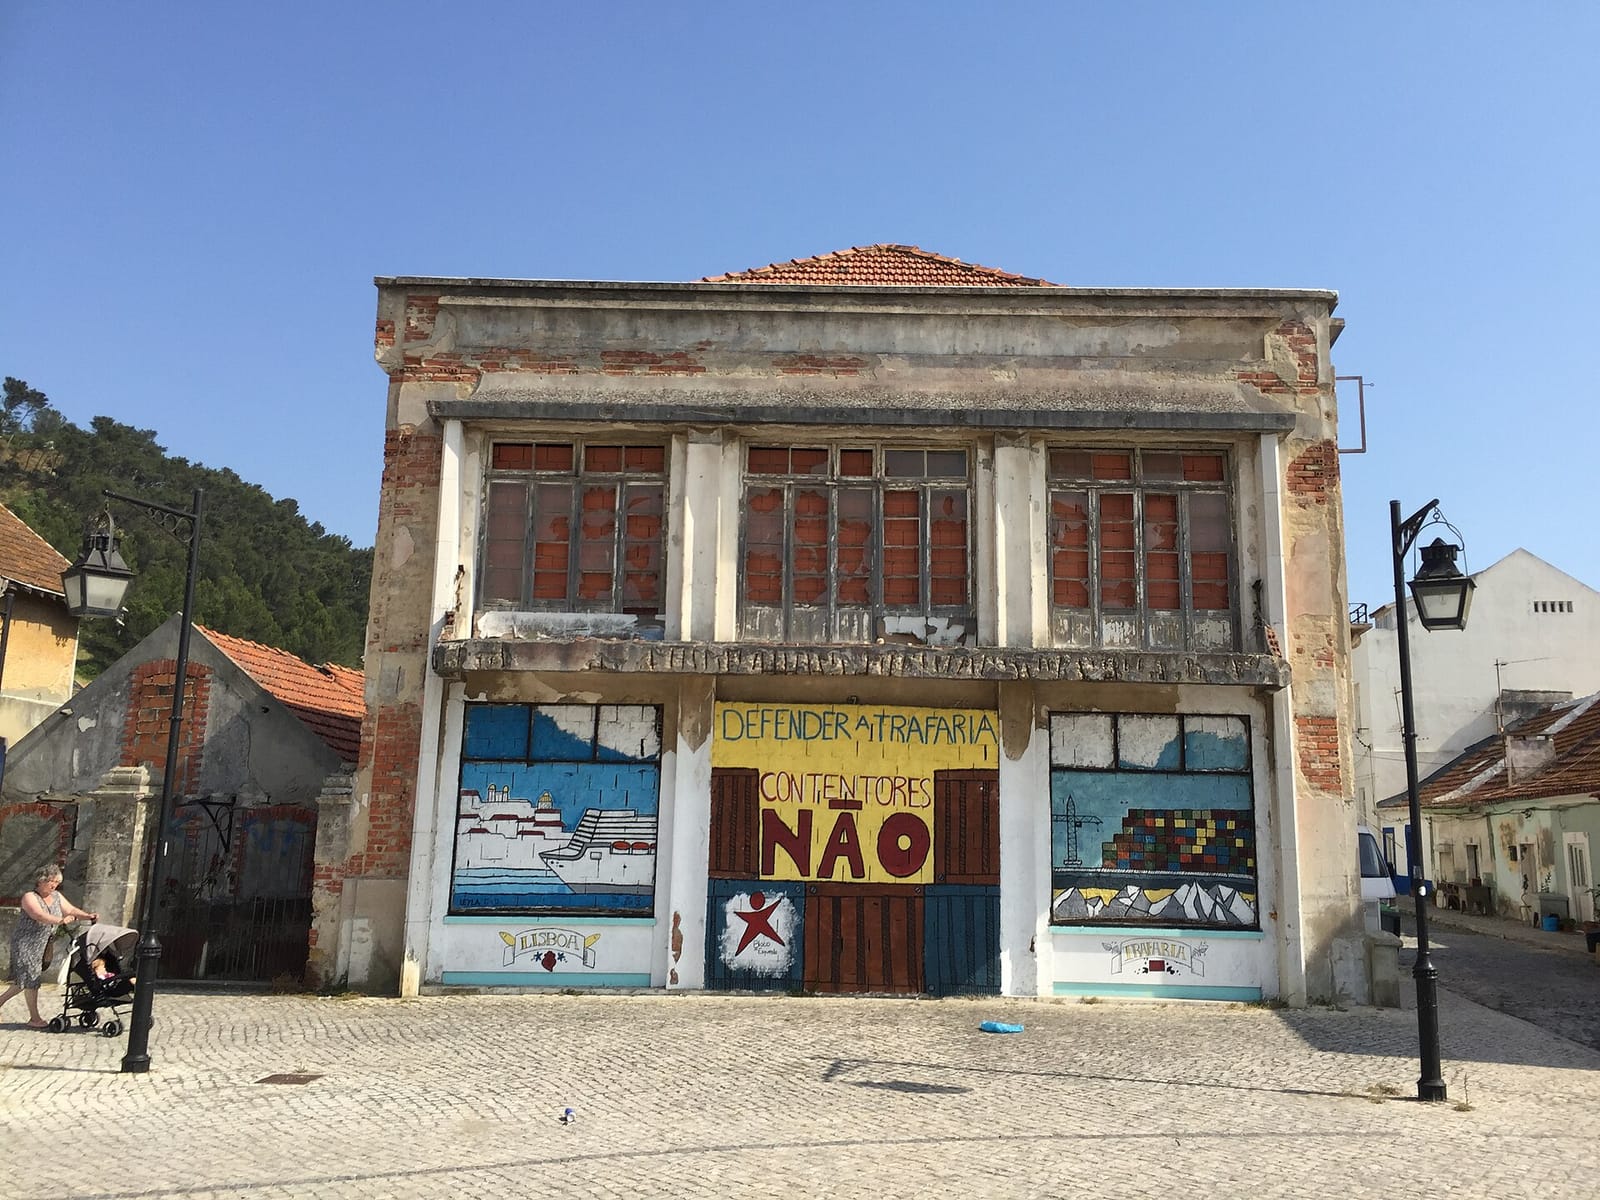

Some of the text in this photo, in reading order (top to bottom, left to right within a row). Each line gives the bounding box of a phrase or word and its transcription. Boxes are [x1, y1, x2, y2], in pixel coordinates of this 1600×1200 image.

[722, 708, 998, 745] DEFENDER A TRAFARIA
[760, 771, 931, 808] CONTENTORES
[761, 799, 931, 879] NÃO
[520, 931, 580, 951] LISBOA
[1124, 941, 1187, 961] TRAFARIA
